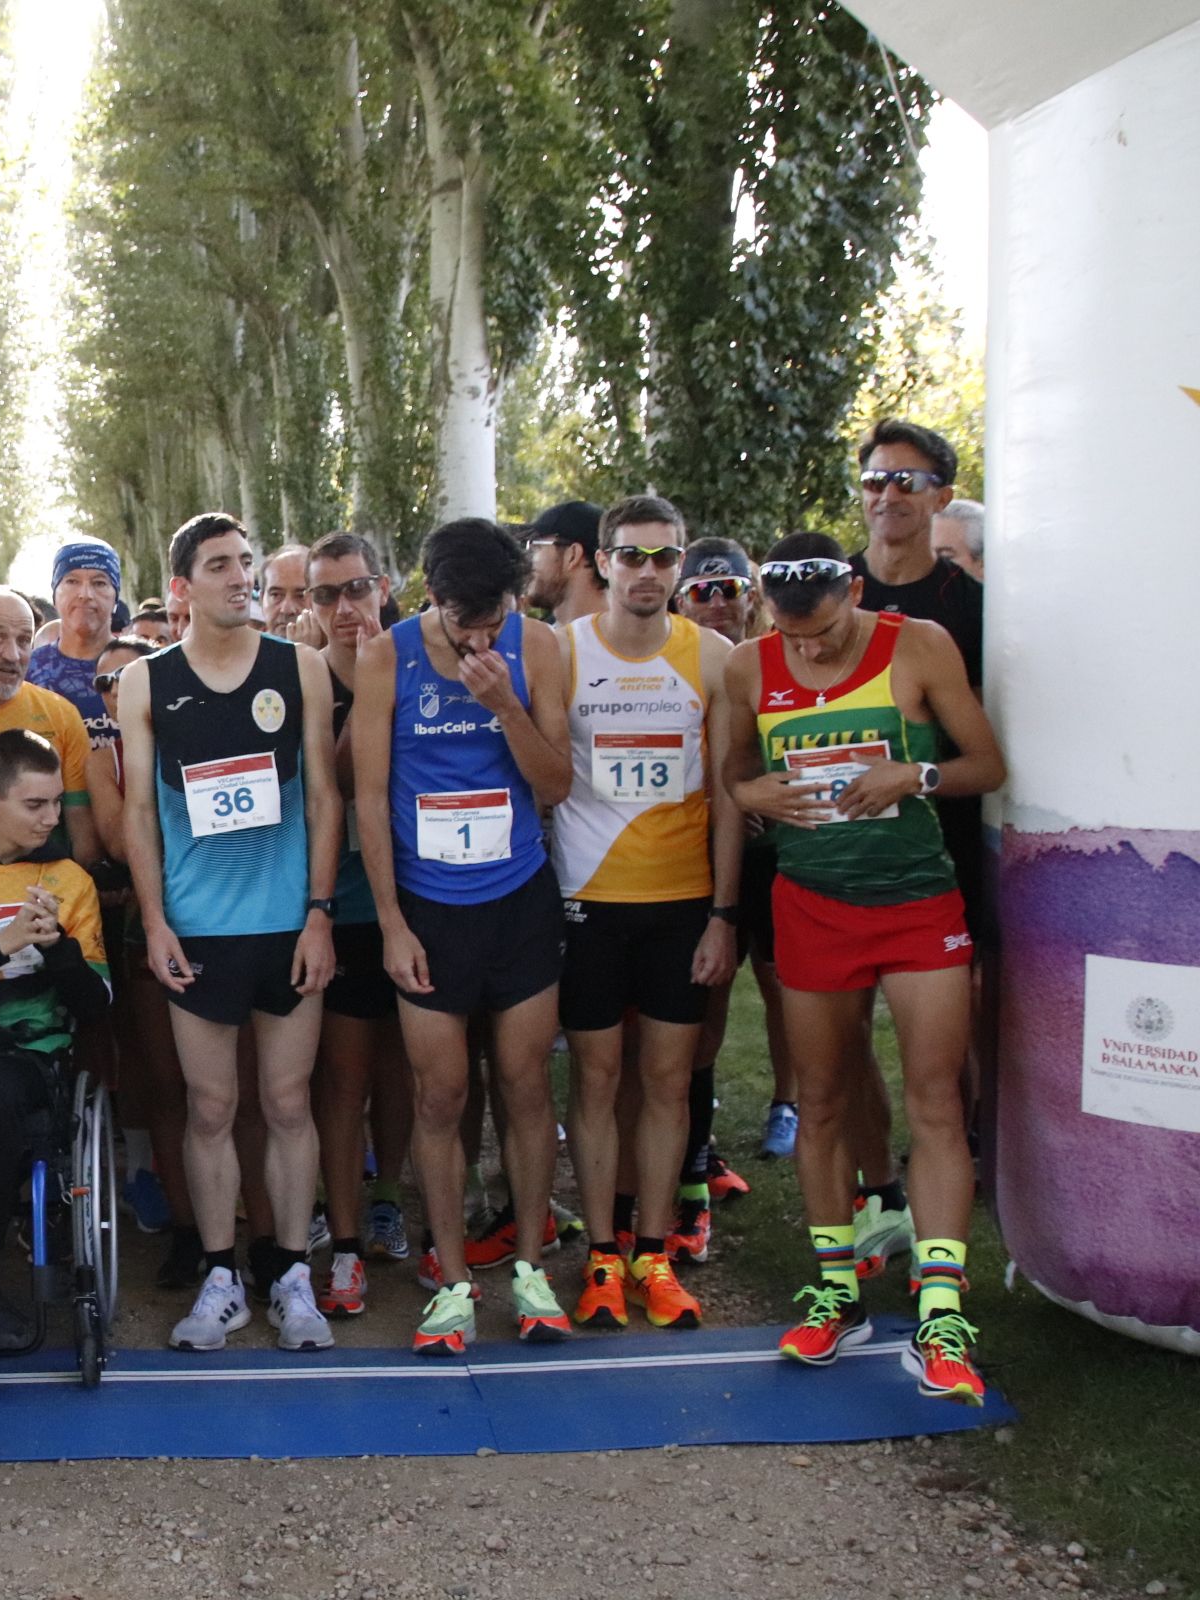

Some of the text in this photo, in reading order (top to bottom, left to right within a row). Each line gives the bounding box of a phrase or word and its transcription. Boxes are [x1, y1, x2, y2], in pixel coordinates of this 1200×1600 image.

[609, 762, 669, 787] 113
[213, 787, 255, 817] 36
[457, 823, 470, 849] 1
